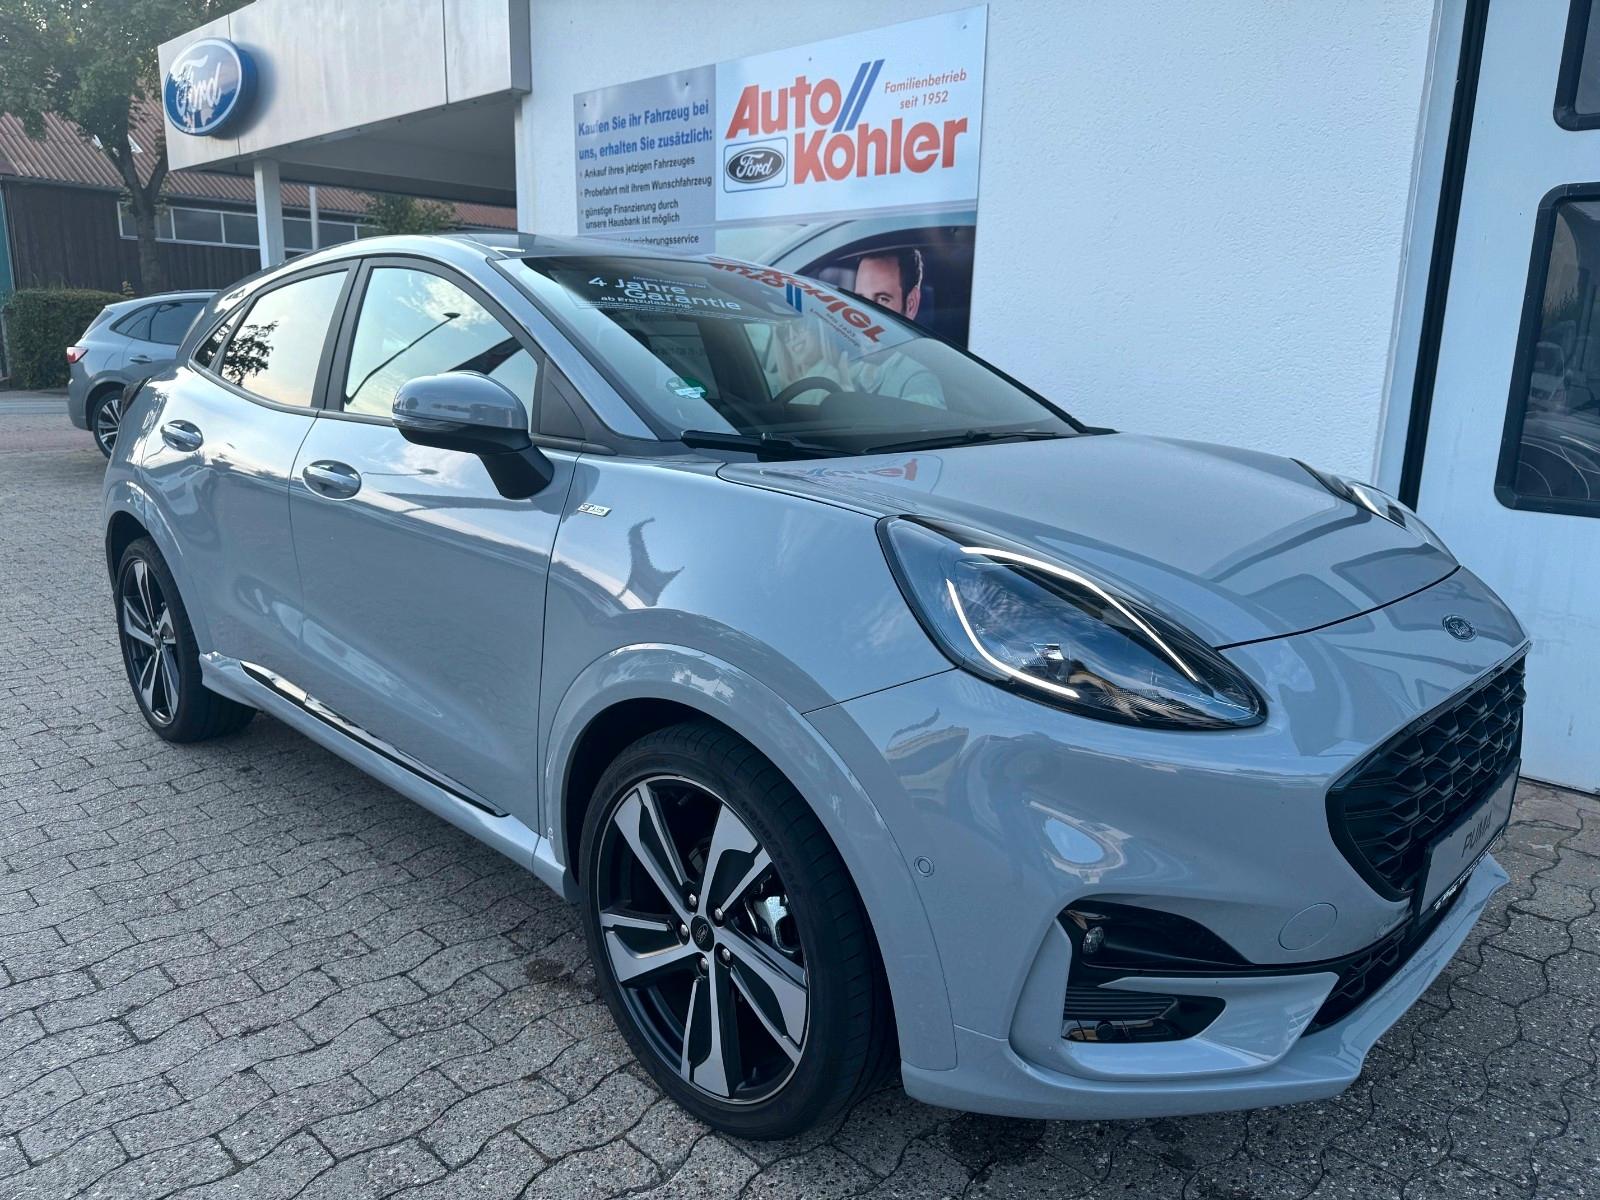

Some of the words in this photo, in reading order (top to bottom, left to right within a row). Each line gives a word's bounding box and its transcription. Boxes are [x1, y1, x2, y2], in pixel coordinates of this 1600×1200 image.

[175, 54, 222, 117] Ford
[884, 68, 967, 94] Familienbetrieb
[725, 76, 842, 139] Auto
[900, 96, 918, 110] seit
[922, 90, 949, 106] 1952
[612, 115, 626, 130] Sie
[629, 113, 641, 128] ihr
[644, 106, 690, 125] Fahrzeug
[693, 100, 709, 117] bei
[579, 148, 598, 161] uns,
[600, 140, 638, 157] erhalten
[640, 136, 655, 151] Sie
[658, 127, 712, 148] zusätzlich:
[584, 166, 607, 179] Ankauf
[608, 164, 625, 176] ihres
[626, 161, 652, 175] jetzigen
[653, 156, 695, 170] Fahrzeuges
[736, 153, 774, 178] Ford
[584, 184, 618, 198] Probefahrt
[619, 183, 630, 194] mit
[651, 176, 712, 190] Wunschfahrzeug
[585, 205, 612, 219] günstige
[614, 202, 656, 215] Finanzierung
[658, 198, 679, 210] durch
[585, 219, 607, 229] unsere
[608, 215, 640, 228] Hausbank
[641, 215, 651, 225] ist
[652, 212, 680, 225] möglich
[588, 277, 607, 287] 4
[615, 278, 686, 295] Jahre
[623, 288, 742, 311] Garantie
